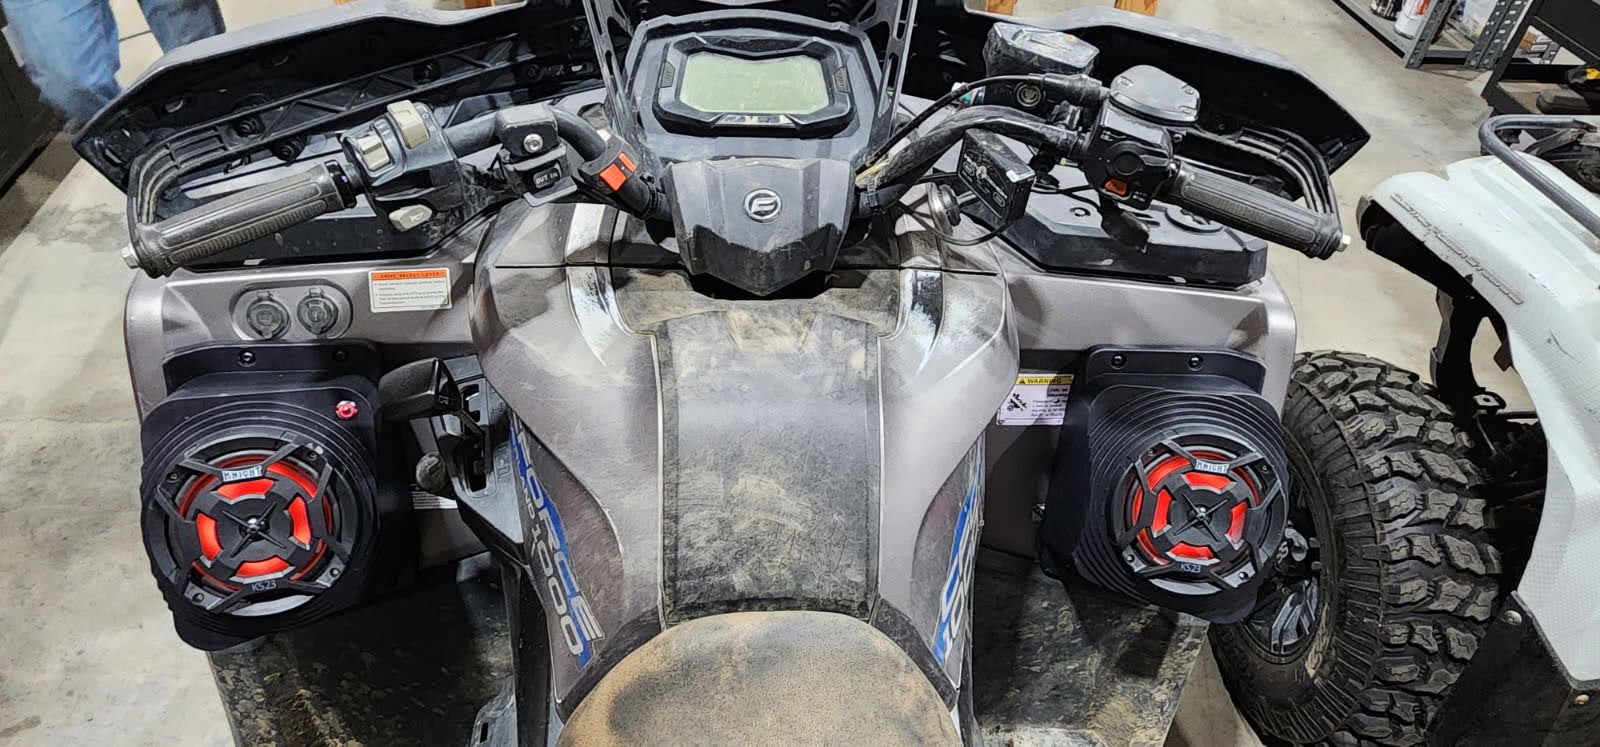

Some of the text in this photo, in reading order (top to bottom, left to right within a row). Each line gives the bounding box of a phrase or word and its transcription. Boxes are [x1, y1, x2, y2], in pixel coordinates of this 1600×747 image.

[535, 170, 558, 185] OUT IN
[1180, 563, 1201, 573] KS23
[251, 579, 277, 592] KS23
[530, 526, 584, 657] 1000
